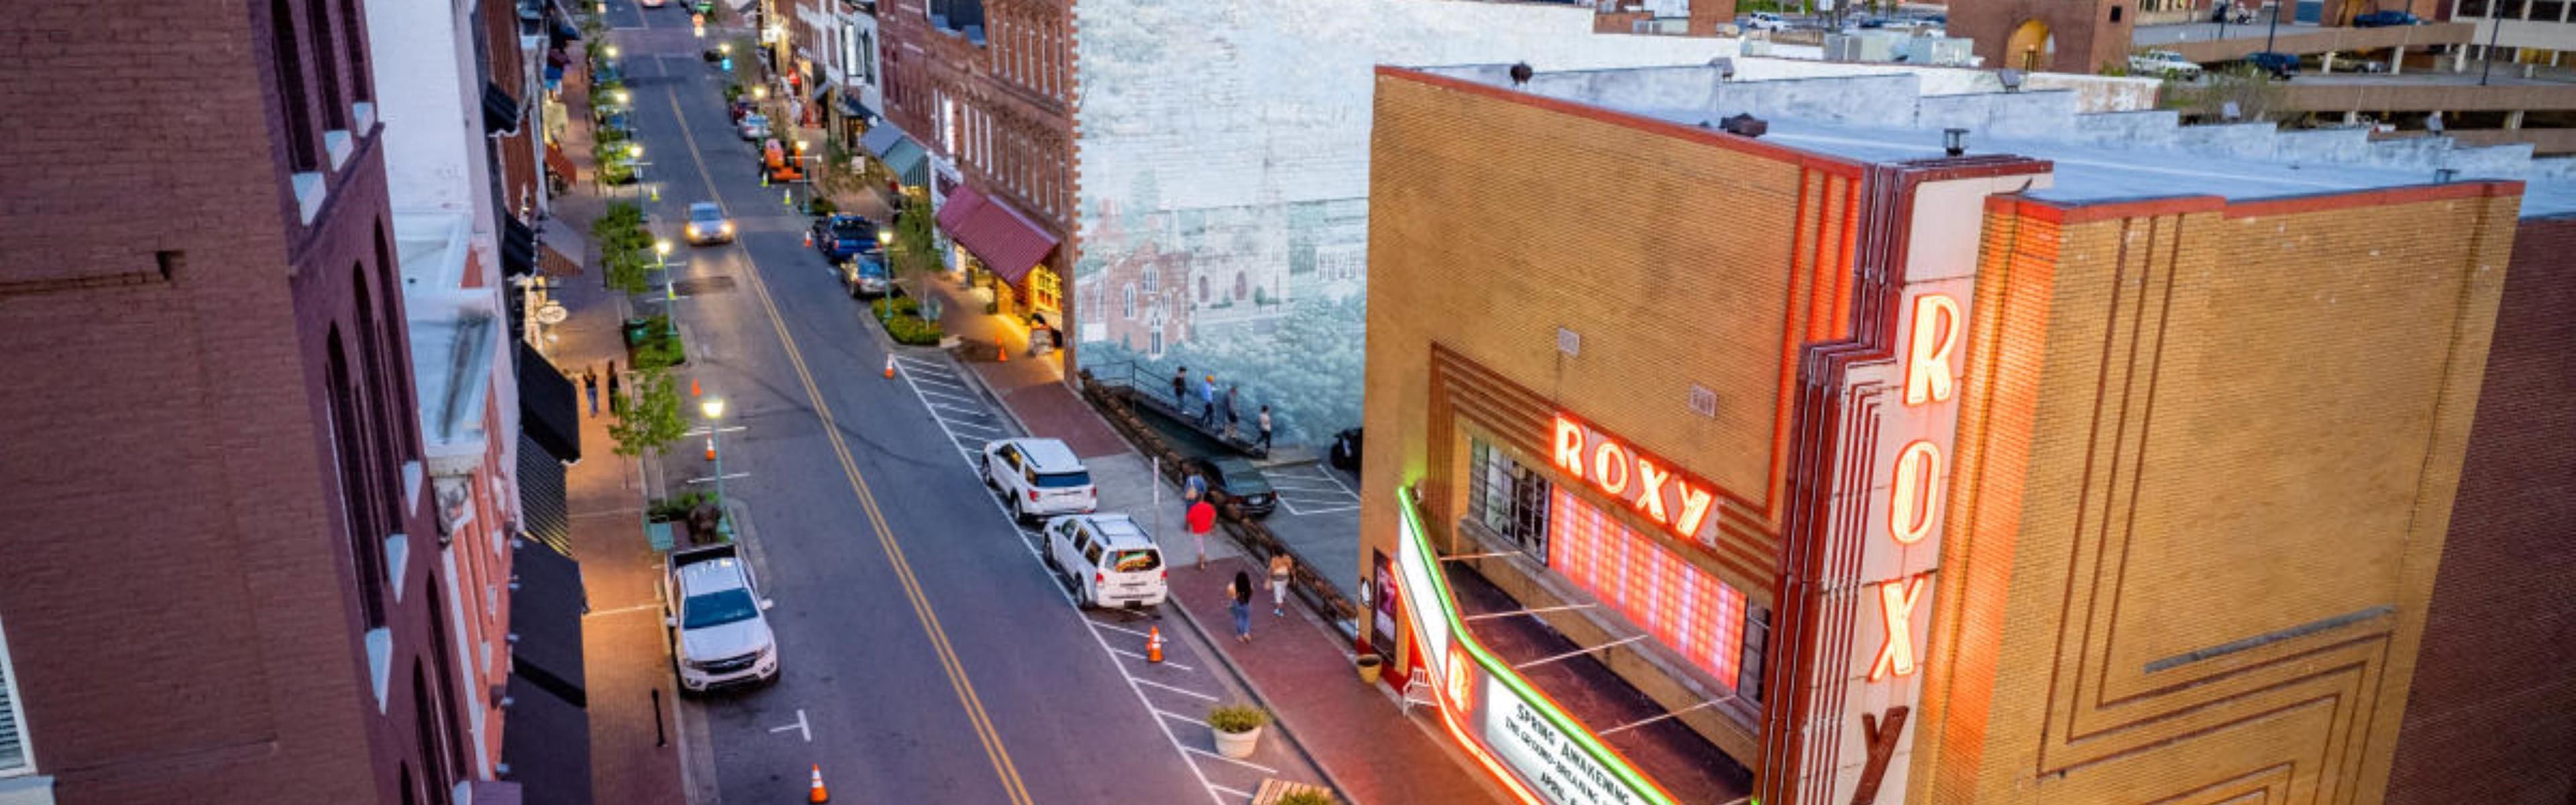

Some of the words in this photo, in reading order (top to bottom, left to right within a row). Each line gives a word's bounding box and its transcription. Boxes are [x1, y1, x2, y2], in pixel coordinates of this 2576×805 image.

[1554, 416, 1713, 538] ROXY
[1851, 294, 1961, 805] ROXY
[1505, 716, 1519, 737] THE
[1517, 703, 1554, 746] SPRING
[1561, 741, 1629, 805] AWAKENING
[1540, 771, 1564, 800] APRIL
